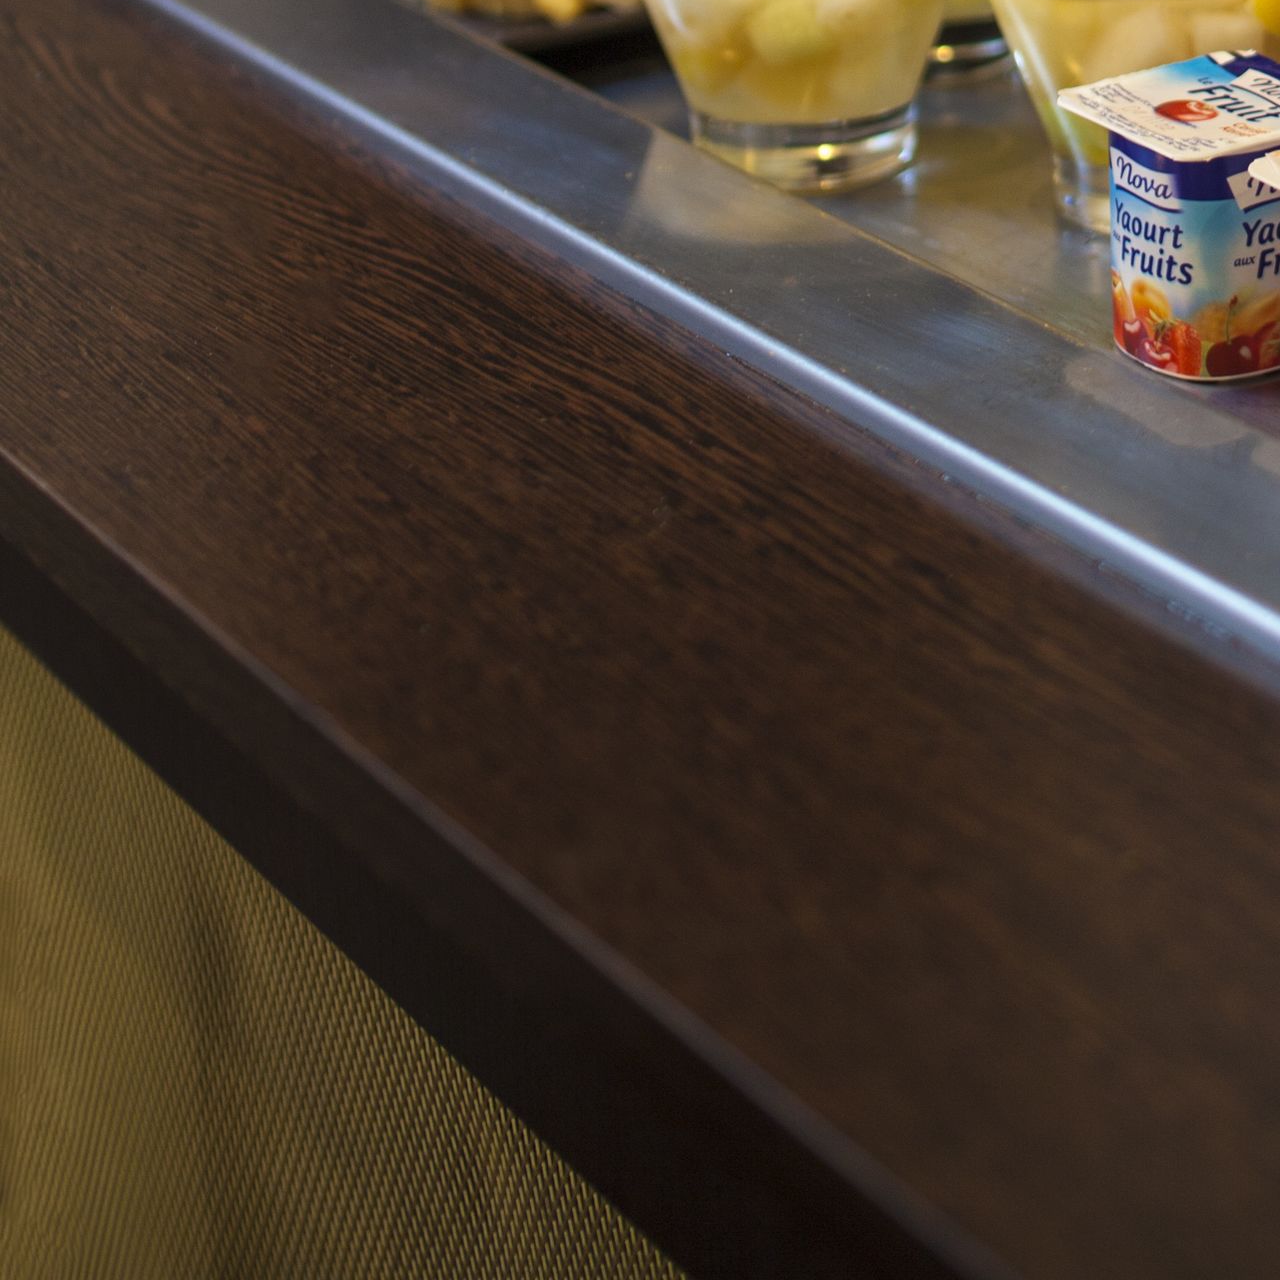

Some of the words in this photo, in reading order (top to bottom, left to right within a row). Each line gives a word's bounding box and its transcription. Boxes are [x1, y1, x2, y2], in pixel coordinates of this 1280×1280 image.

[1115, 155, 1173, 200] Nova
[1114, 197, 1184, 250] Yaourt
[1119, 234, 1194, 285] Fruits
[1234, 255, 1256, 268] aux
